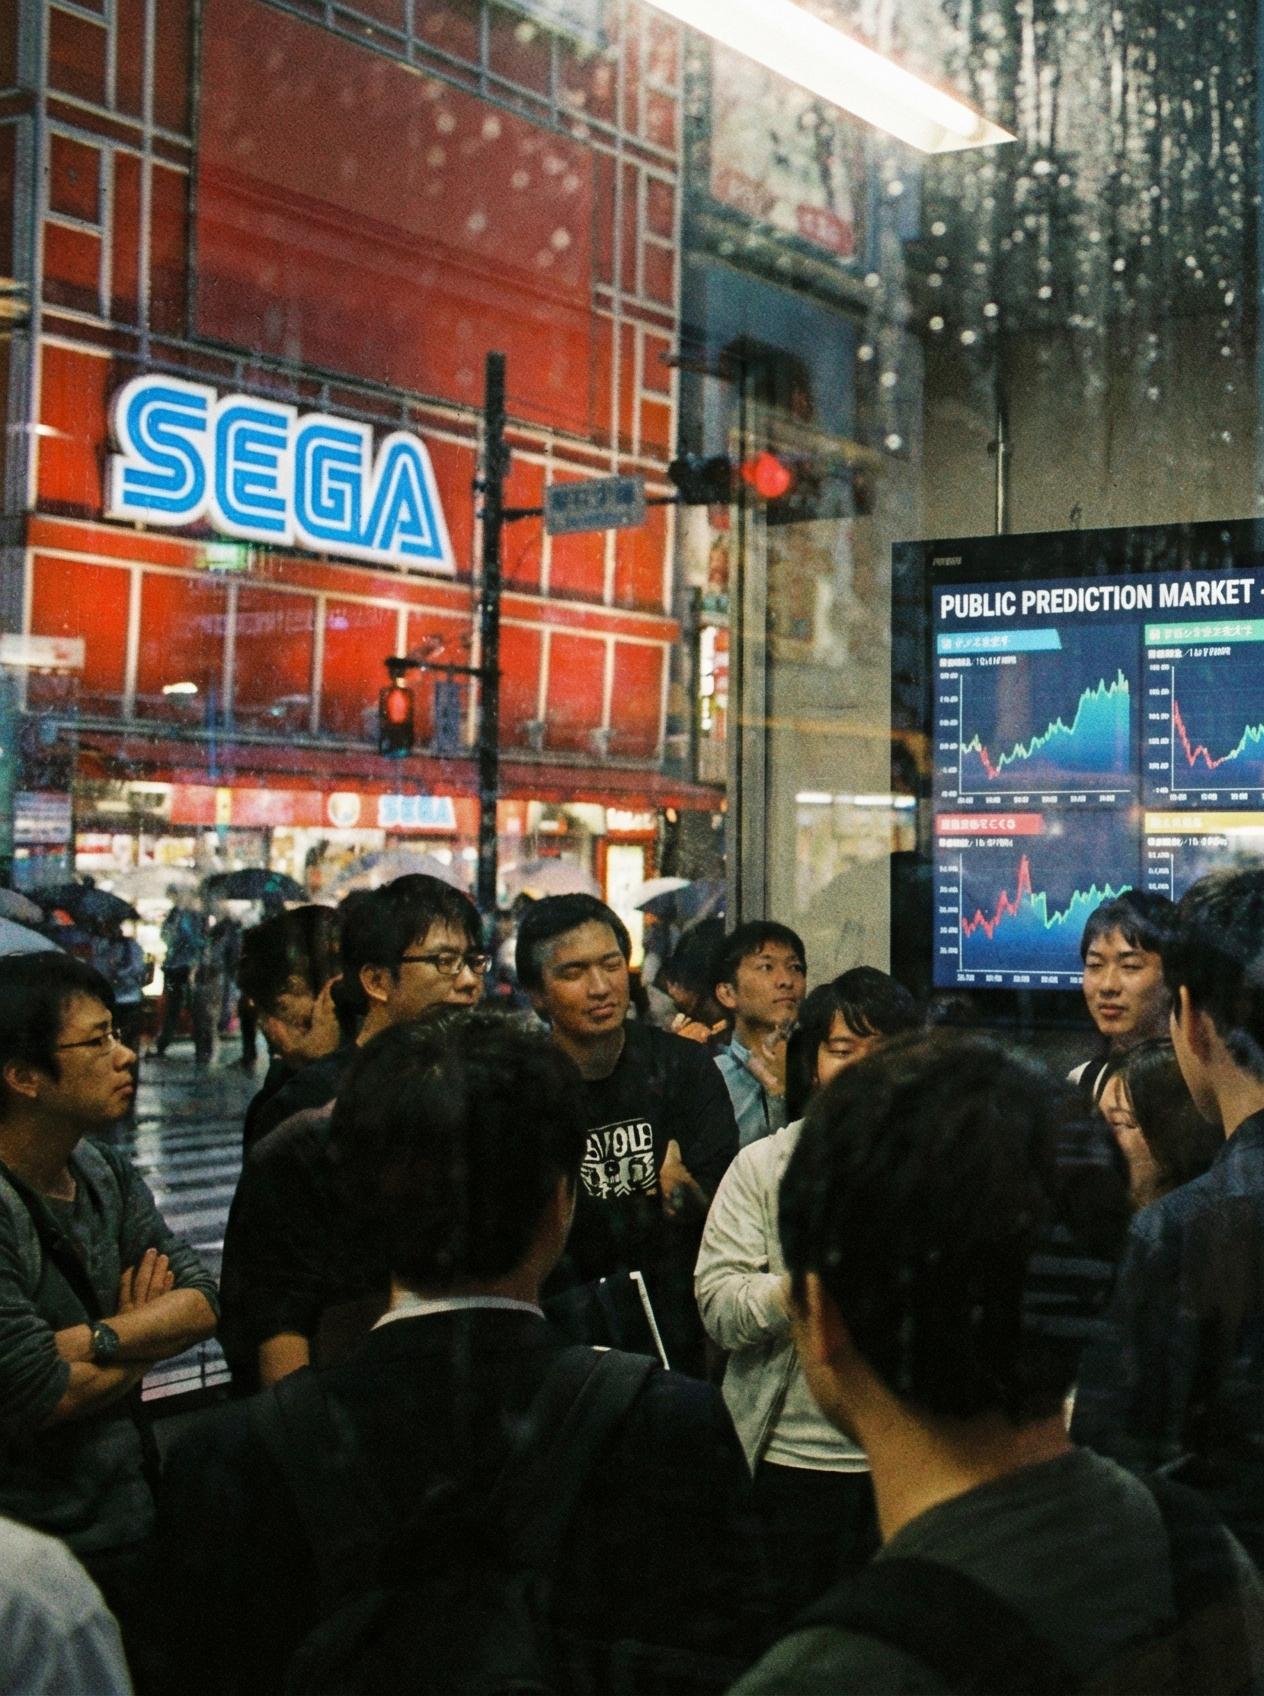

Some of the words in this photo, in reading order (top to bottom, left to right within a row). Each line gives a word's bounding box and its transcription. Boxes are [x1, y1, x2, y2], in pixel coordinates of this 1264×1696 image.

[112, 378, 451, 570] SEGA
[940, 591, 1017, 619] PUBLIC
[1021, 583, 1153, 615] PREDICTION
[1159, 578, 1255, 608] MARKET
